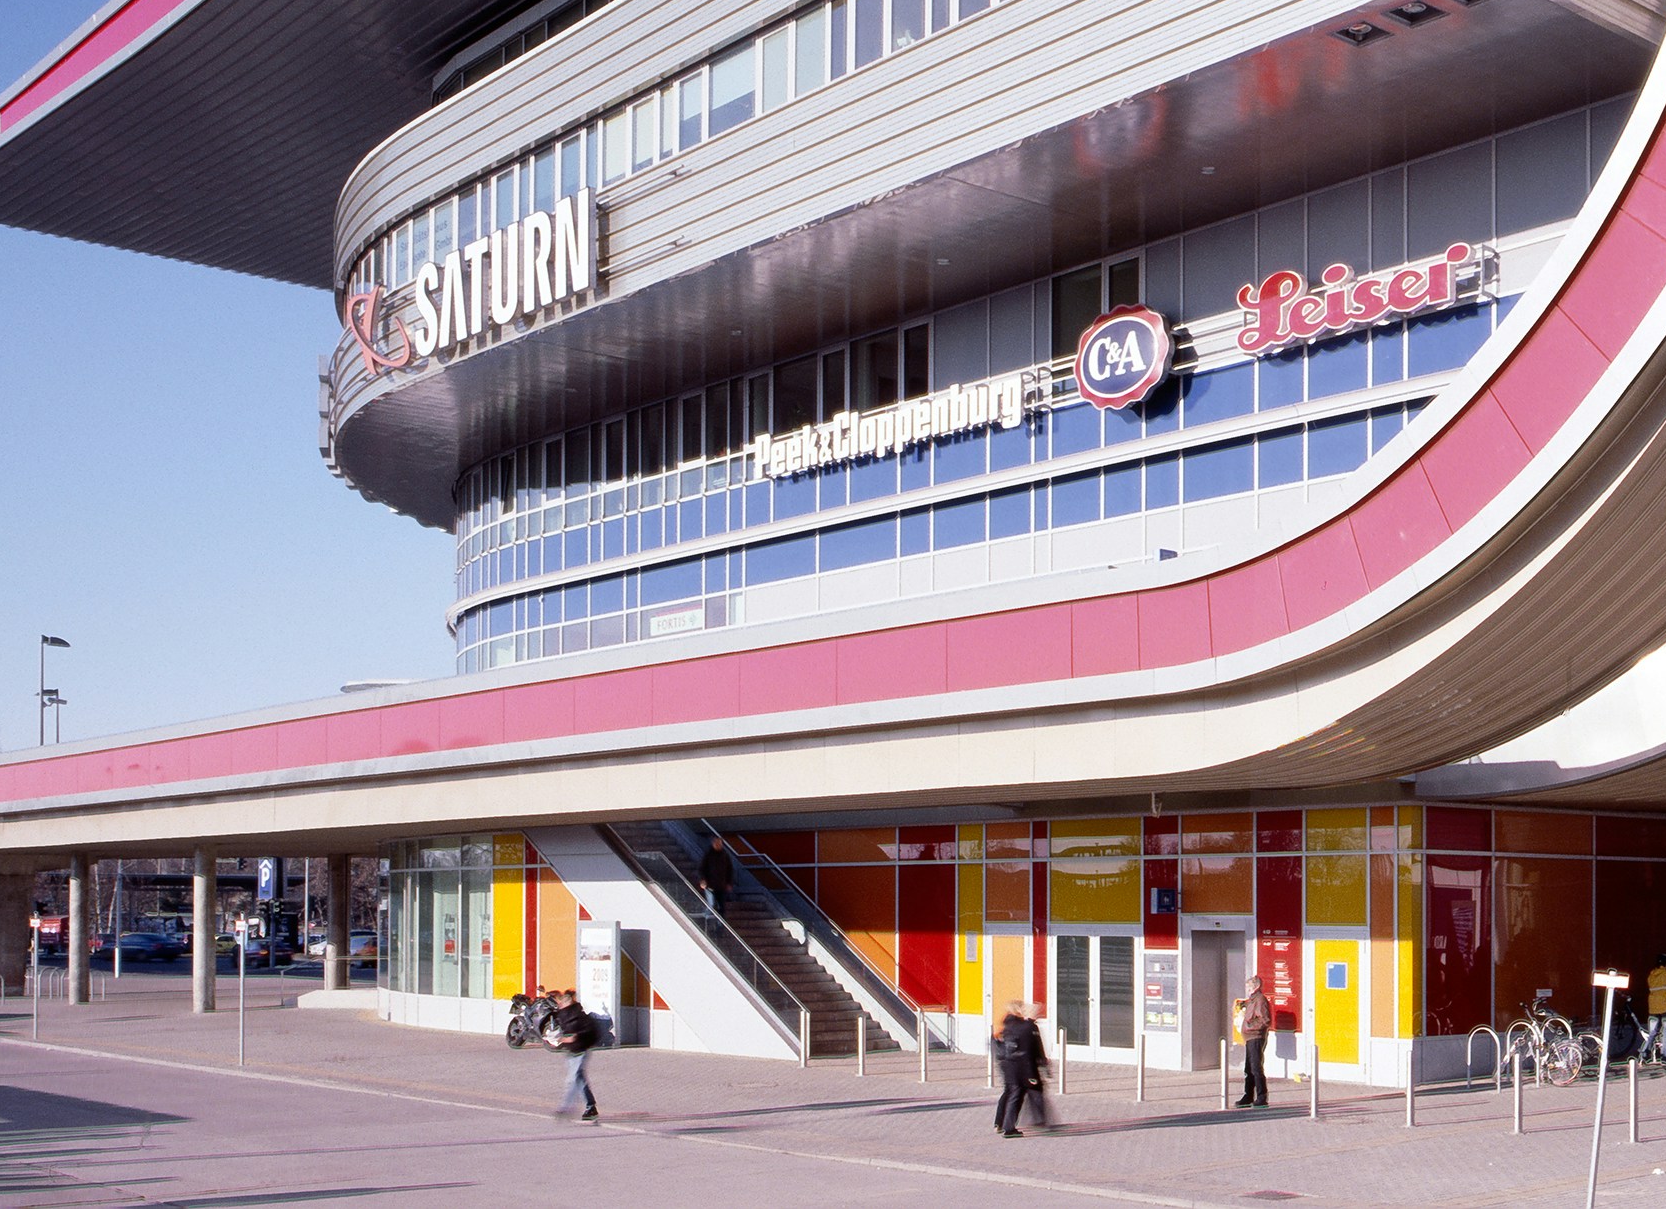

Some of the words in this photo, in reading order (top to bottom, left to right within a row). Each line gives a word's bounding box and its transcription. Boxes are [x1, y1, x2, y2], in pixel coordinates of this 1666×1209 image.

[415, 186, 590, 357] SATURN
[1236, 242, 1473, 356] Leiser
[1087, 329, 1147, 383] C&A
[753, 372, 1023, 480] Peek&Cloppenburg
[656, 615, 687, 630] FORTIS
[260, 867, 271, 888] P
